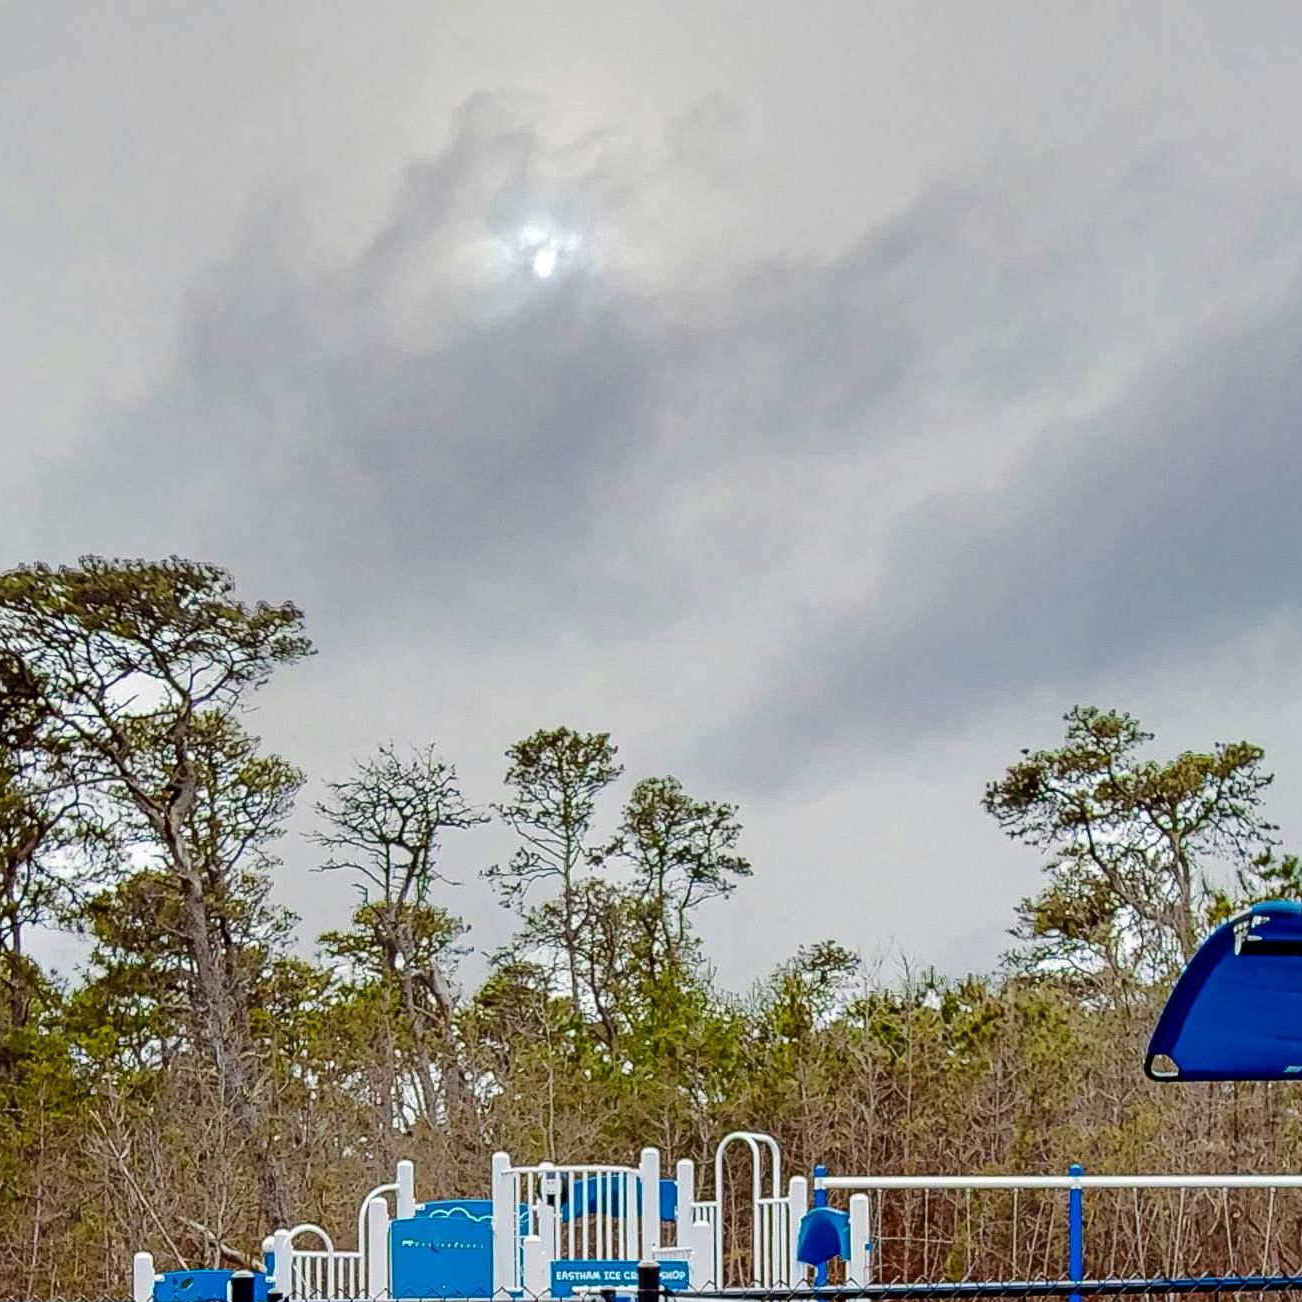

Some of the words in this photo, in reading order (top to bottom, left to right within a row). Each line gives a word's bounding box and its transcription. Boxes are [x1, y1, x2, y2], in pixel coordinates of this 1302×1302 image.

[555, 1270, 601, 1281] EASTHAM
[603, 1270, 621, 1281] ICE
[658, 1270, 686, 1281] SHOP
